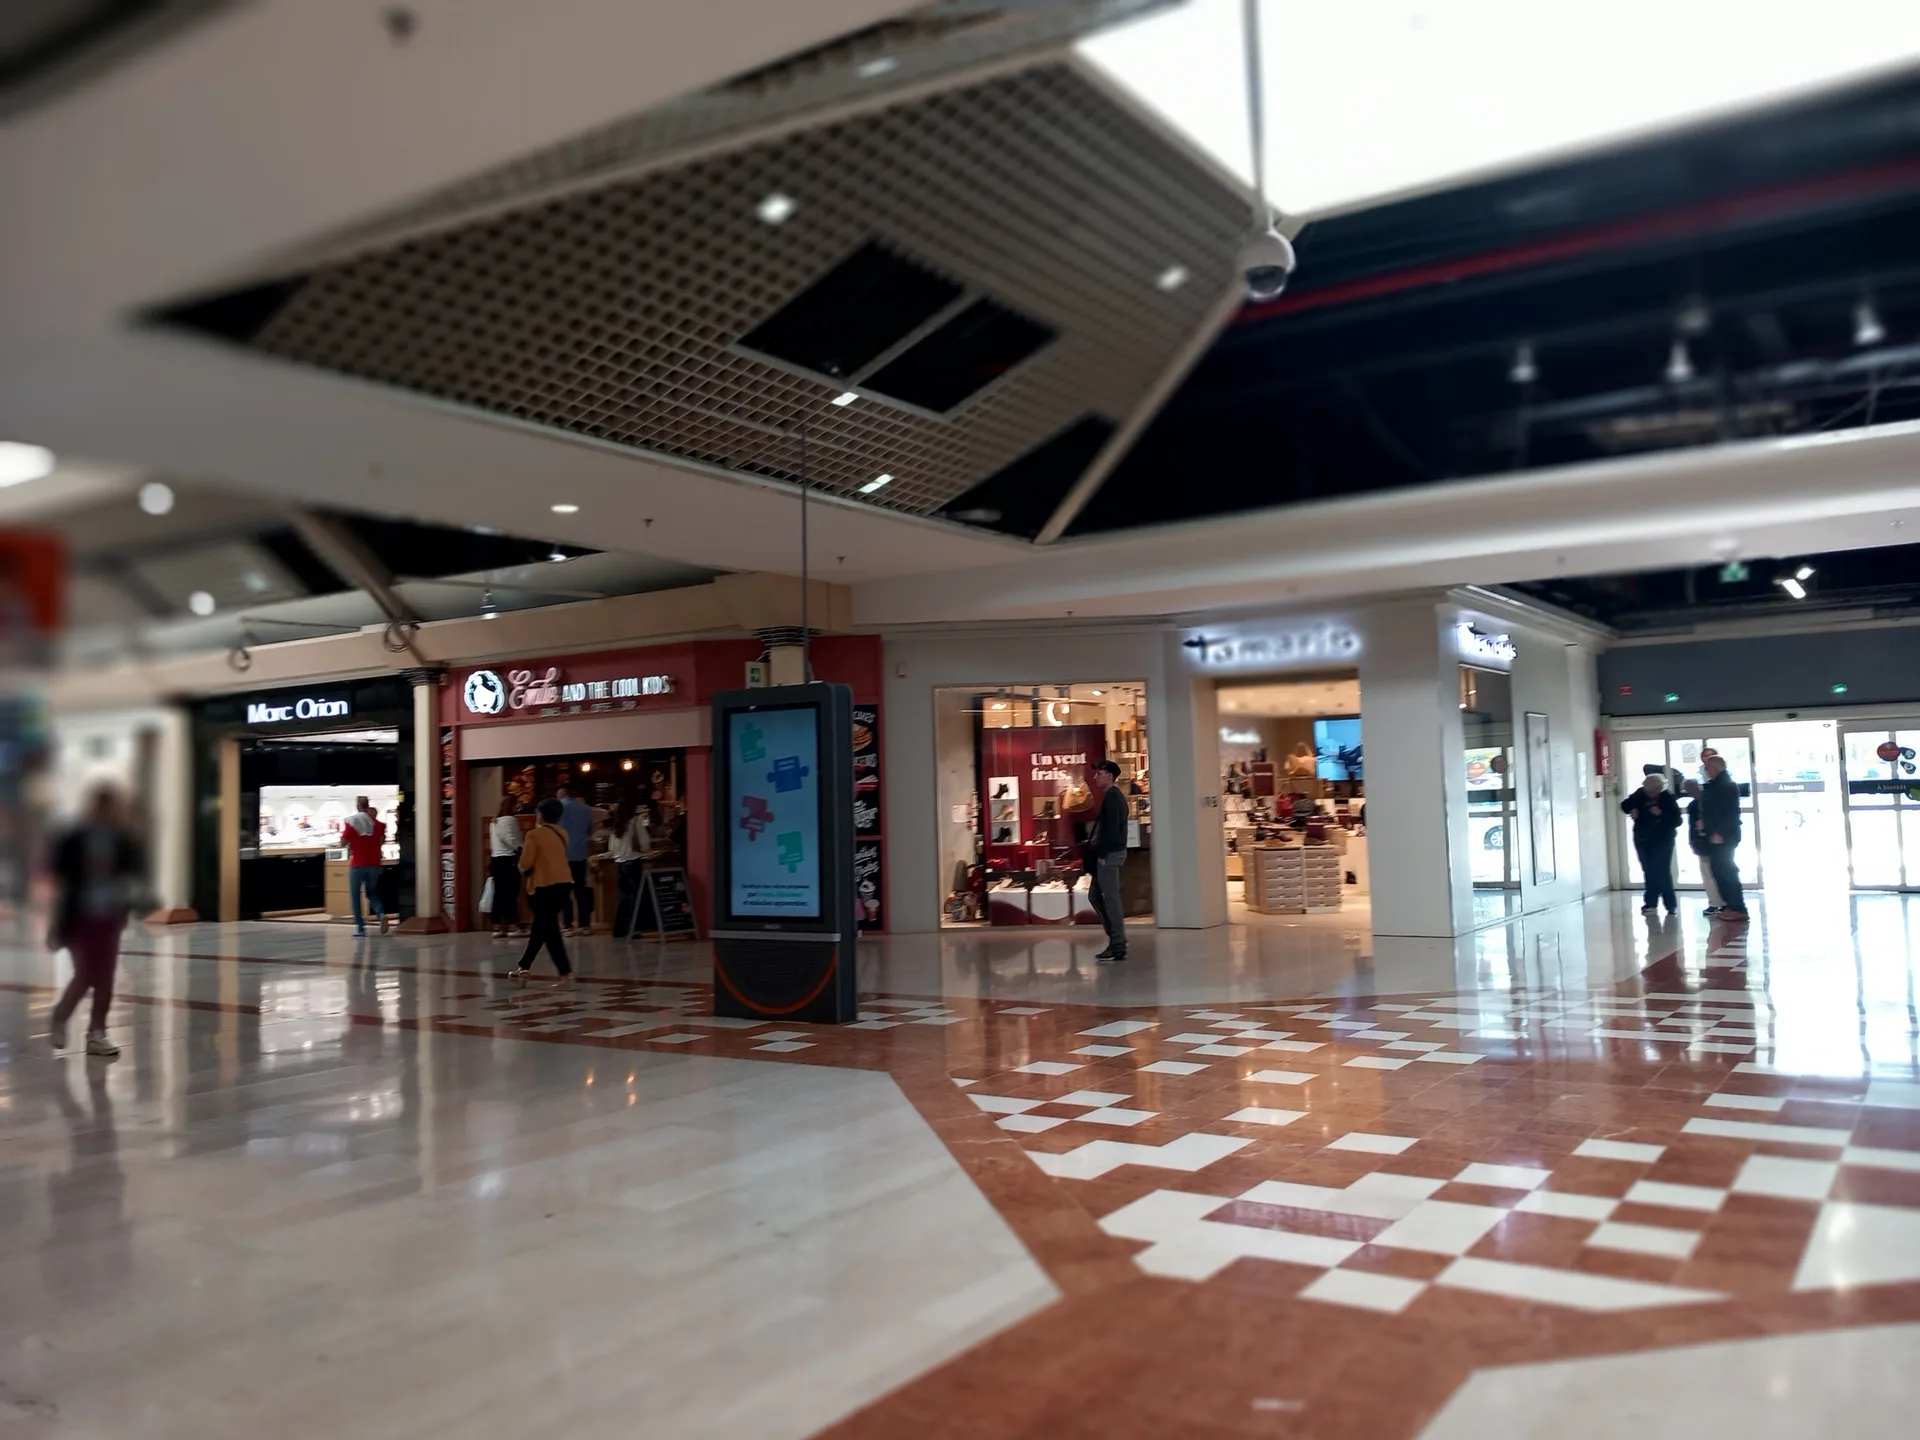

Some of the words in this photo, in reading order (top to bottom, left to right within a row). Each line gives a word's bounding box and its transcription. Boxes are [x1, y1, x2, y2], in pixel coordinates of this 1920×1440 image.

[562, 683, 586, 702] AND
[586, 680, 611, 699] THE
[642, 675, 671, 695] KIDS
[247, 703, 294, 723] Marc
[295, 698, 348, 719] Orion
[1031, 753, 1053, 766] Un
[1053, 752, 1087, 765] vent
[1031, 767, 1073, 781] frais.
